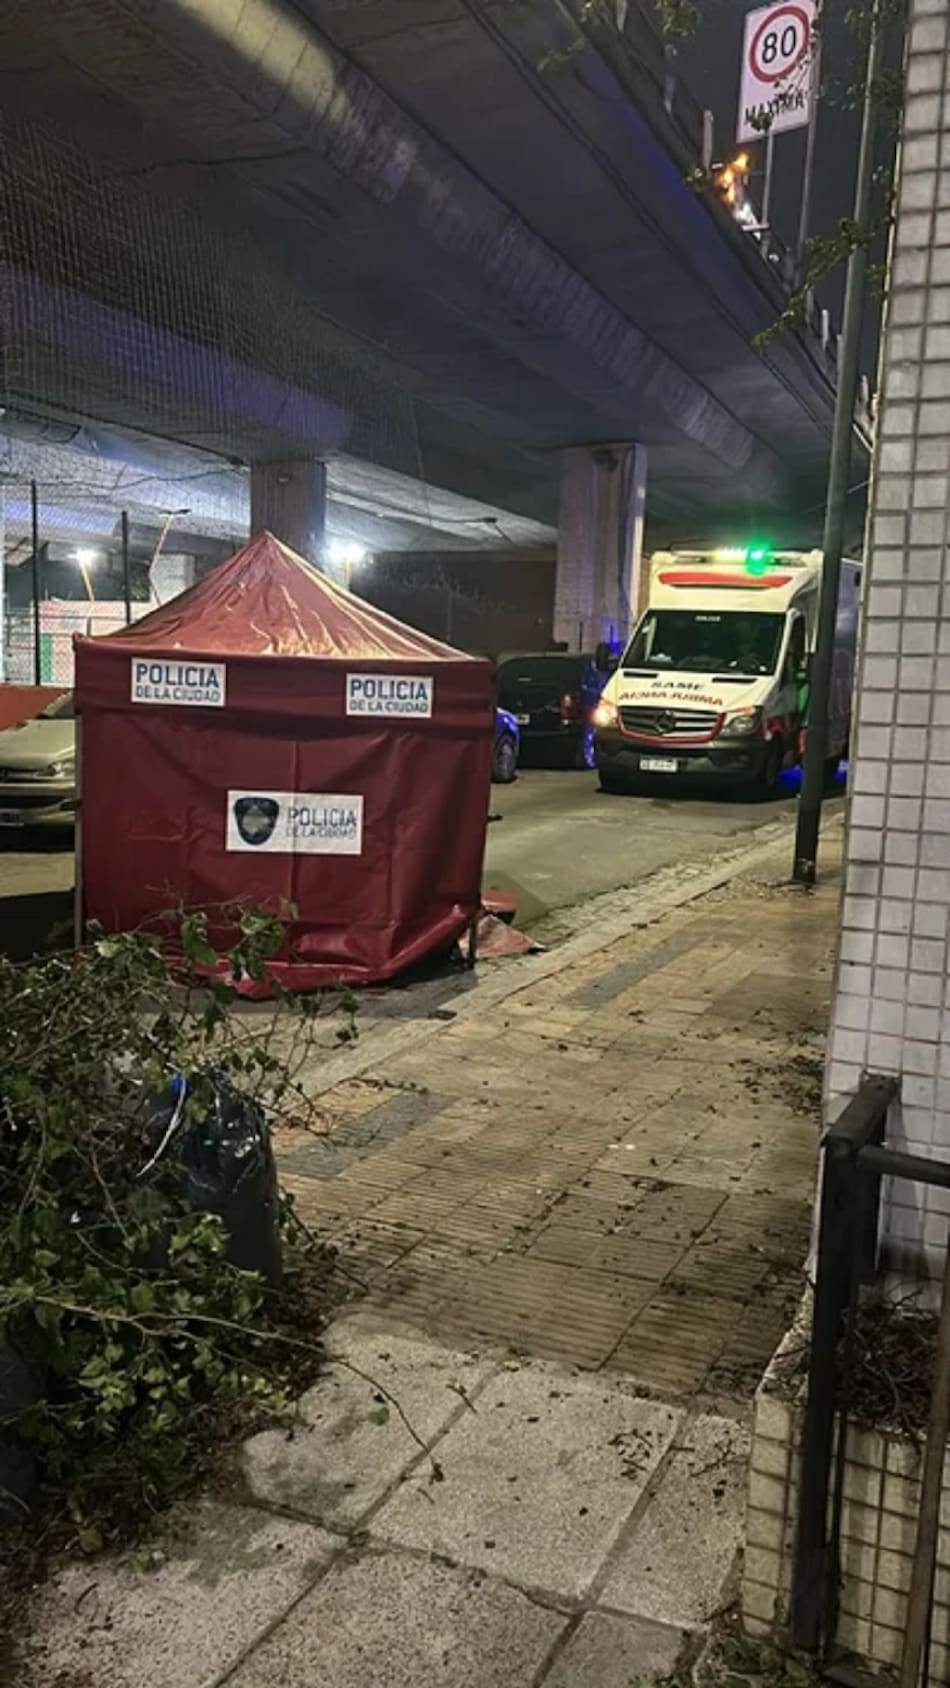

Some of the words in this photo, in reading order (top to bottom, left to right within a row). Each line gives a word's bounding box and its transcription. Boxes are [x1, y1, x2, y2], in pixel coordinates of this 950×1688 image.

[762, 25, 797, 63] 80
[136, 663, 219, 688] POLICIA
[136, 685, 151, 698] DE
[154, 687, 171, 699] LA
[173, 687, 220, 702] CIUDAD
[351, 679, 428, 700] POLICIA
[350, 700, 366, 711] DE
[368, 701, 383, 711] LA
[287, 806, 357, 827] POLICIA
[302, 827, 316, 838] LA
